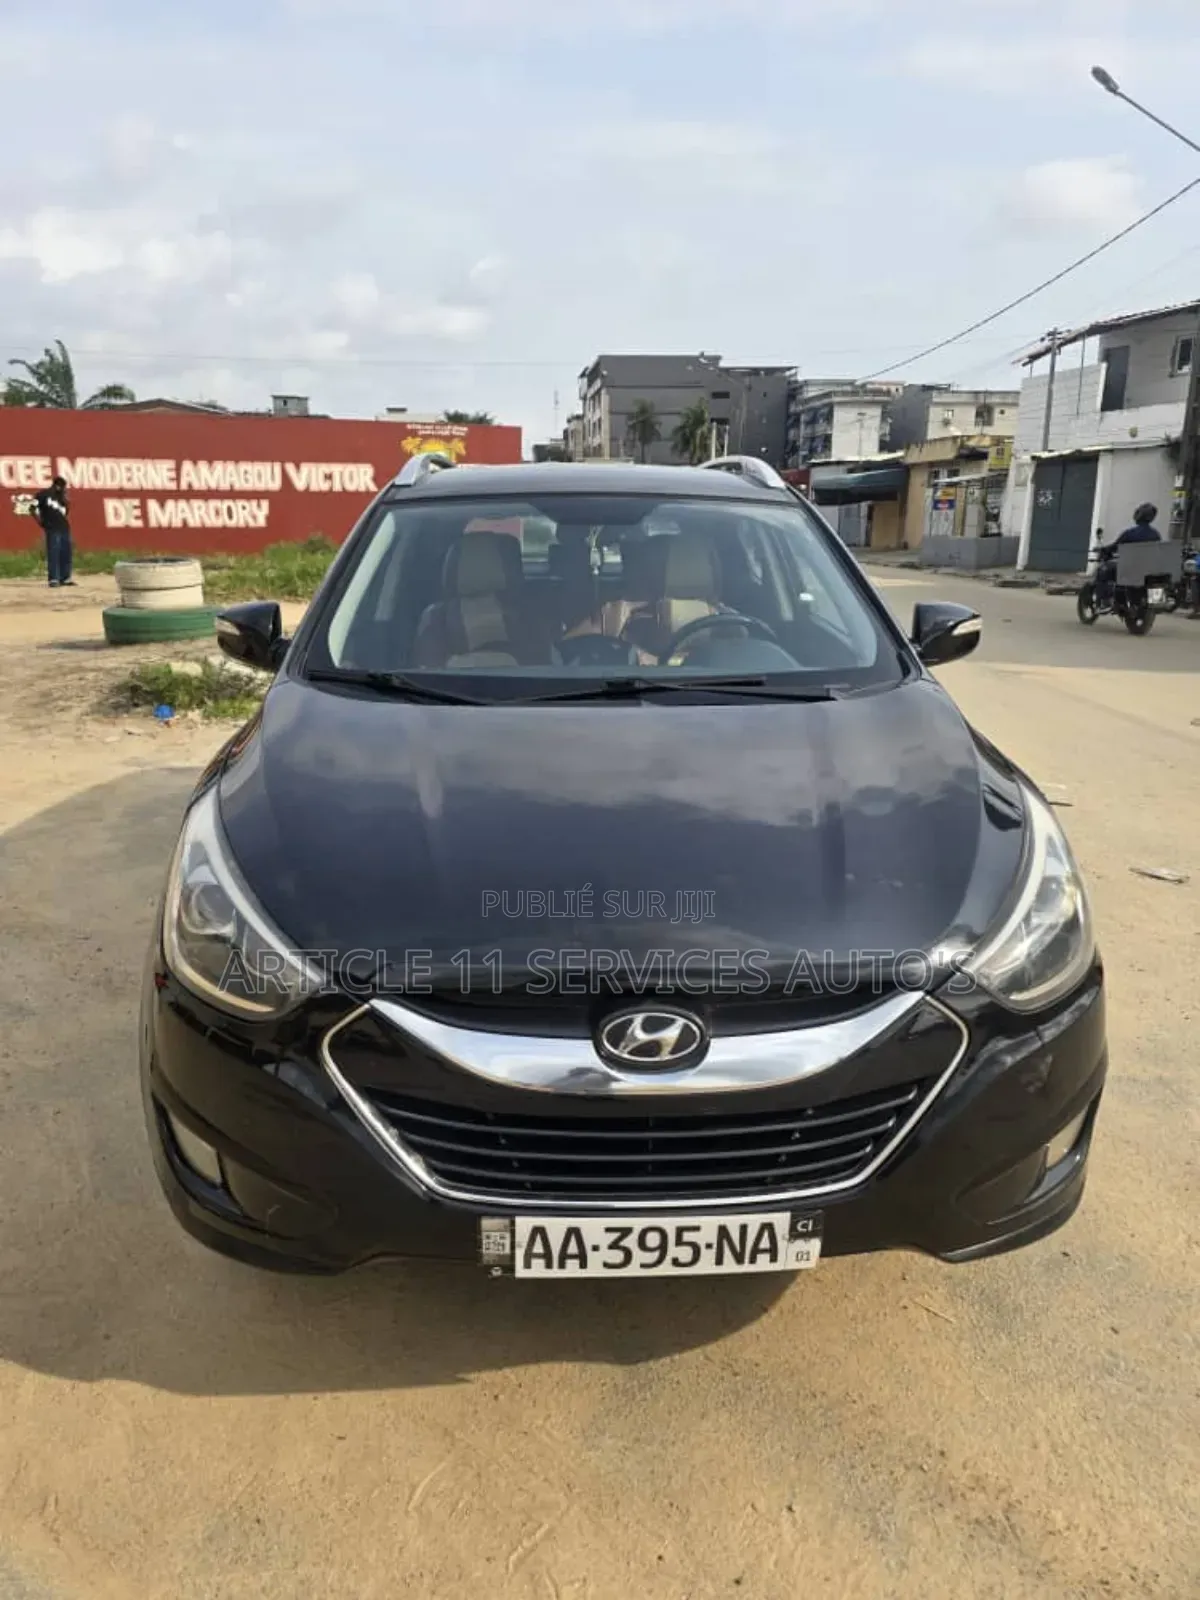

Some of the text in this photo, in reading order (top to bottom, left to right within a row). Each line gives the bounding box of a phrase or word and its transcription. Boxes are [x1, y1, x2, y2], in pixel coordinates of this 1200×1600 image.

[56, 457, 177, 490] MODERNE
[180, 460, 282, 491] AMAGOU
[284, 462, 378, 492] VICTOR
[103, 498, 269, 528] DE MARCORY
